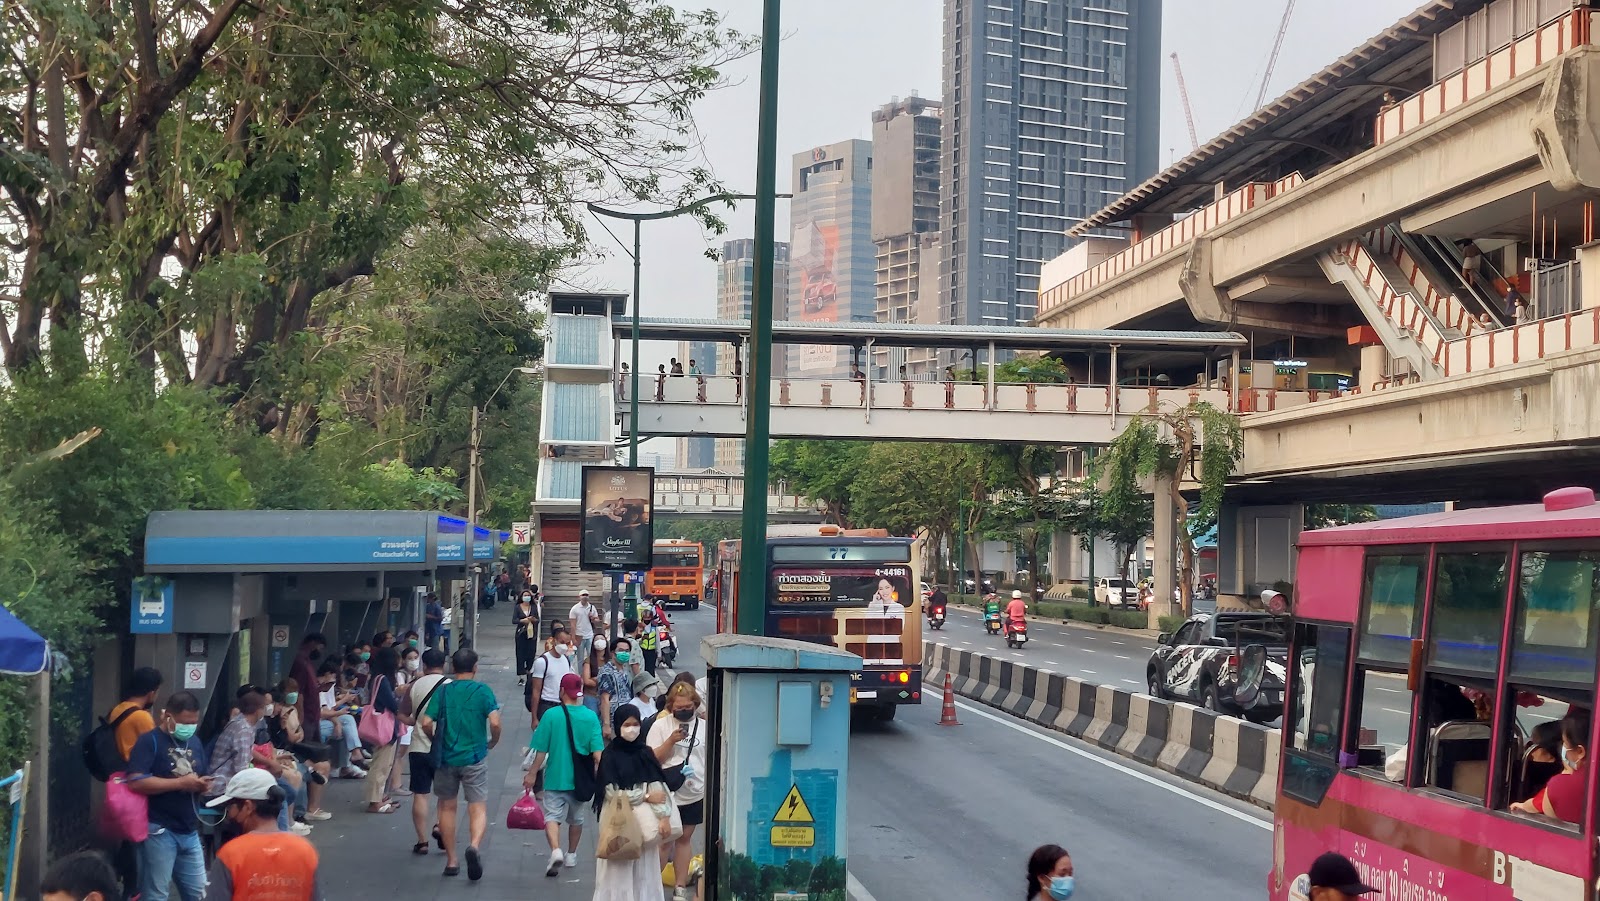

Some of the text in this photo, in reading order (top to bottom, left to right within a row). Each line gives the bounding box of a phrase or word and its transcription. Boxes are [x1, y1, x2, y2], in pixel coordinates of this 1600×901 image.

[381, 540, 420, 550] สวนจตุจักร
[829, 547, 849, 560] 77
[779, 571, 831, 583] ทำตาสองชั้น
[874, 568, 905, 576] 4-44161
